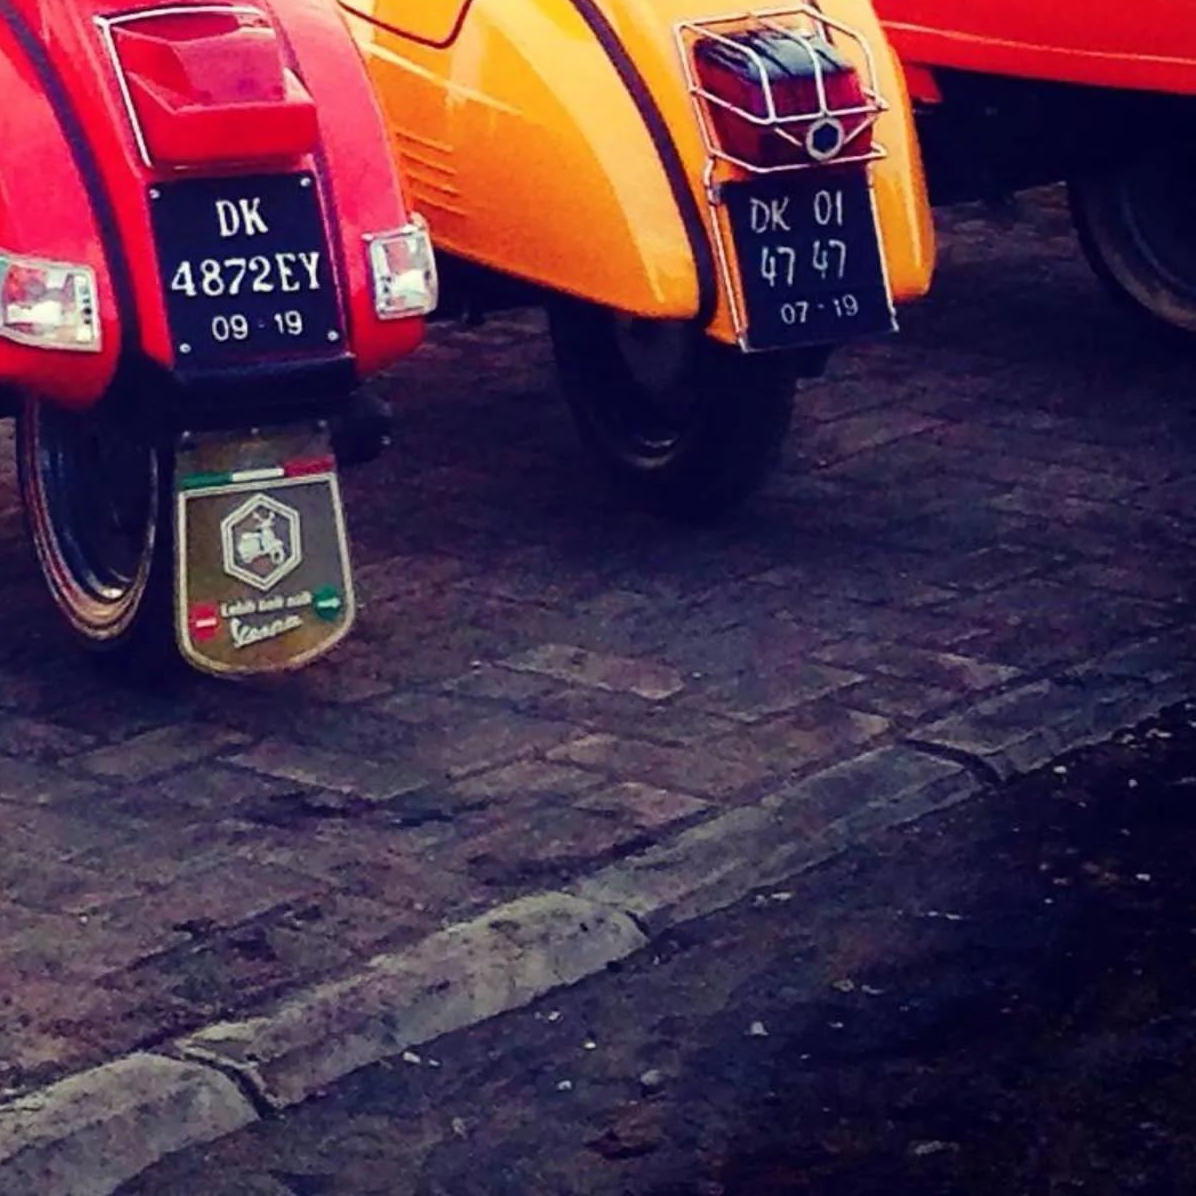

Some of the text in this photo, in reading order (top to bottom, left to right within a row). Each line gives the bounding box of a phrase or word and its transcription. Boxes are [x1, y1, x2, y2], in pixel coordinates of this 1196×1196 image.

[215, 197, 269, 237] DK
[750, 196, 791, 234] DK
[171, 251, 321, 297] 4872EY
